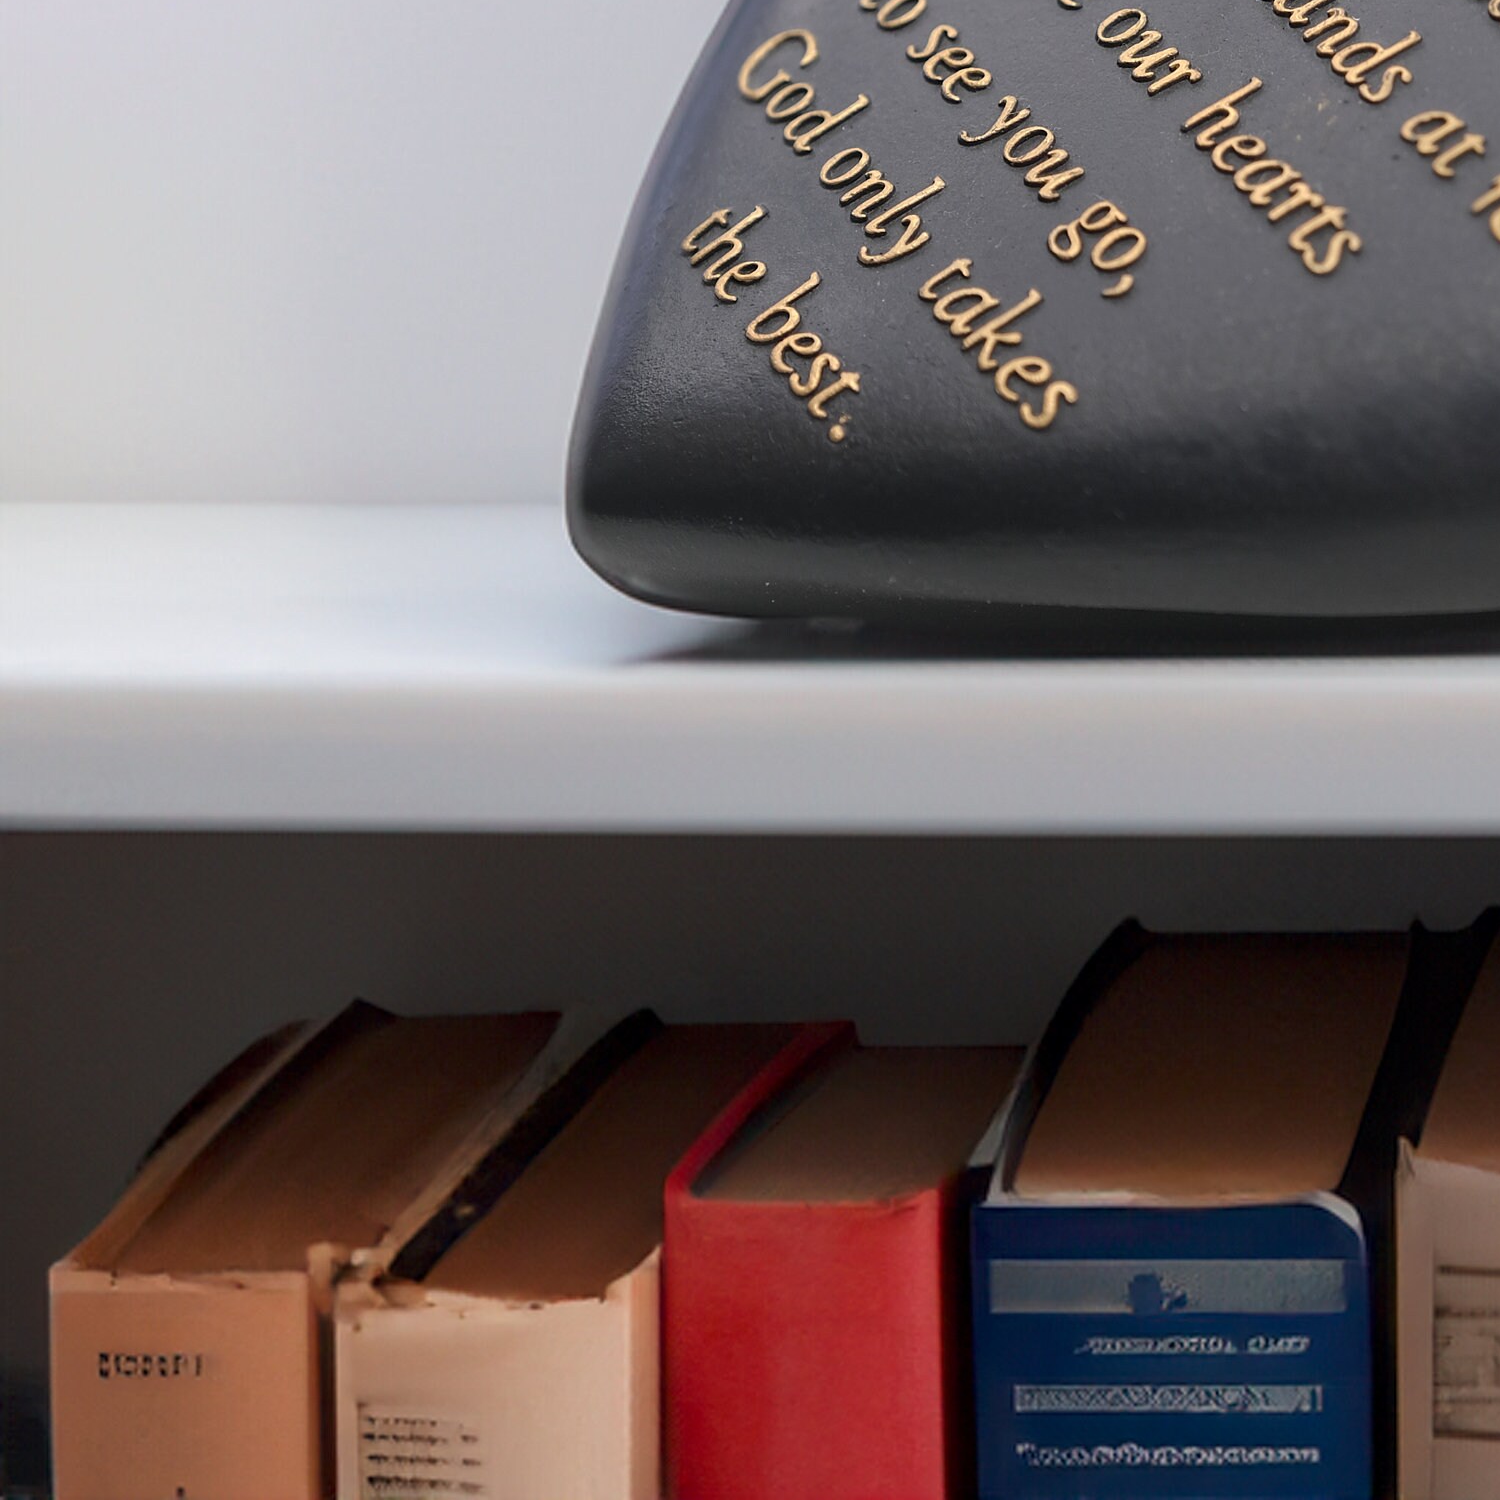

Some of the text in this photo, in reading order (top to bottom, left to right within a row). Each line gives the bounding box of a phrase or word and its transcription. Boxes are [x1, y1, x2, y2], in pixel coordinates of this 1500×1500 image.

[738, 29, 1079, 430] God only takes
[906, 24, 992, 104] see
[958, 95, 1086, 201] you
[1048, 200, 1147, 299] go,
[1097, 8, 1202, 95] our
[1181, 77, 1362, 275] hearts
[1401, 110, 1485, 178] at
[680, 204, 861, 442] the best.
